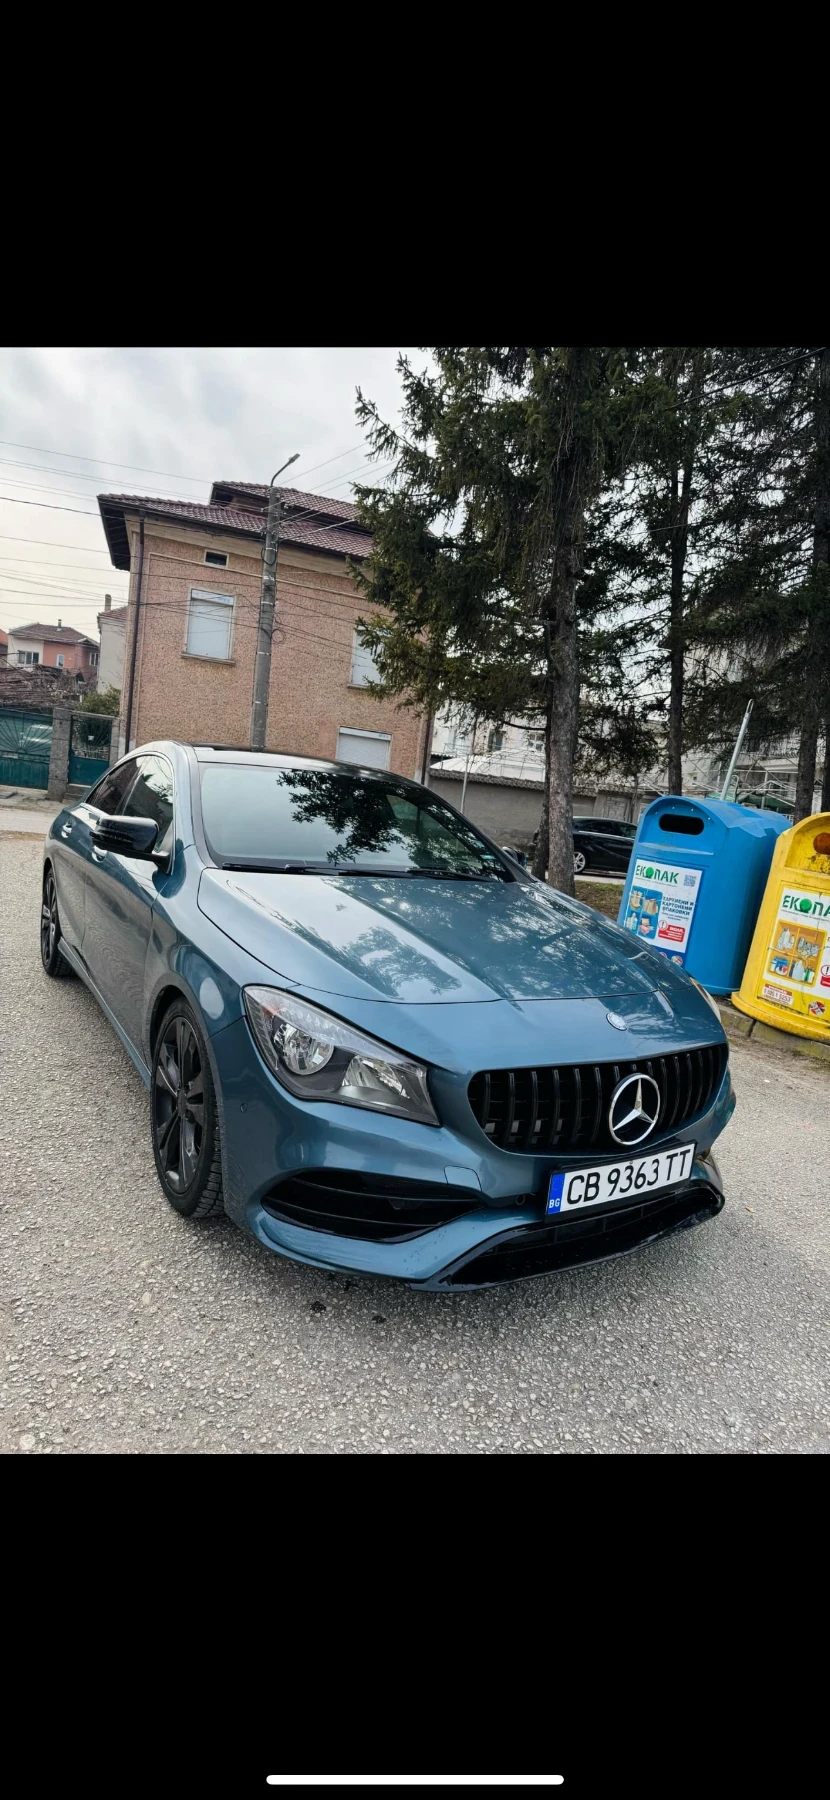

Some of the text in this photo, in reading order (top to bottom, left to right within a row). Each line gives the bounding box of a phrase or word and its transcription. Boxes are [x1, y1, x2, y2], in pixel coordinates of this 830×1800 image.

[635, 865, 680, 884] ЕКОПАК
[662, 907, 690, 916] ОПАКОВКИ
[566, 1149, 691, 1205] CB 9363 TT
[549, 1198, 560, 1208] BG
